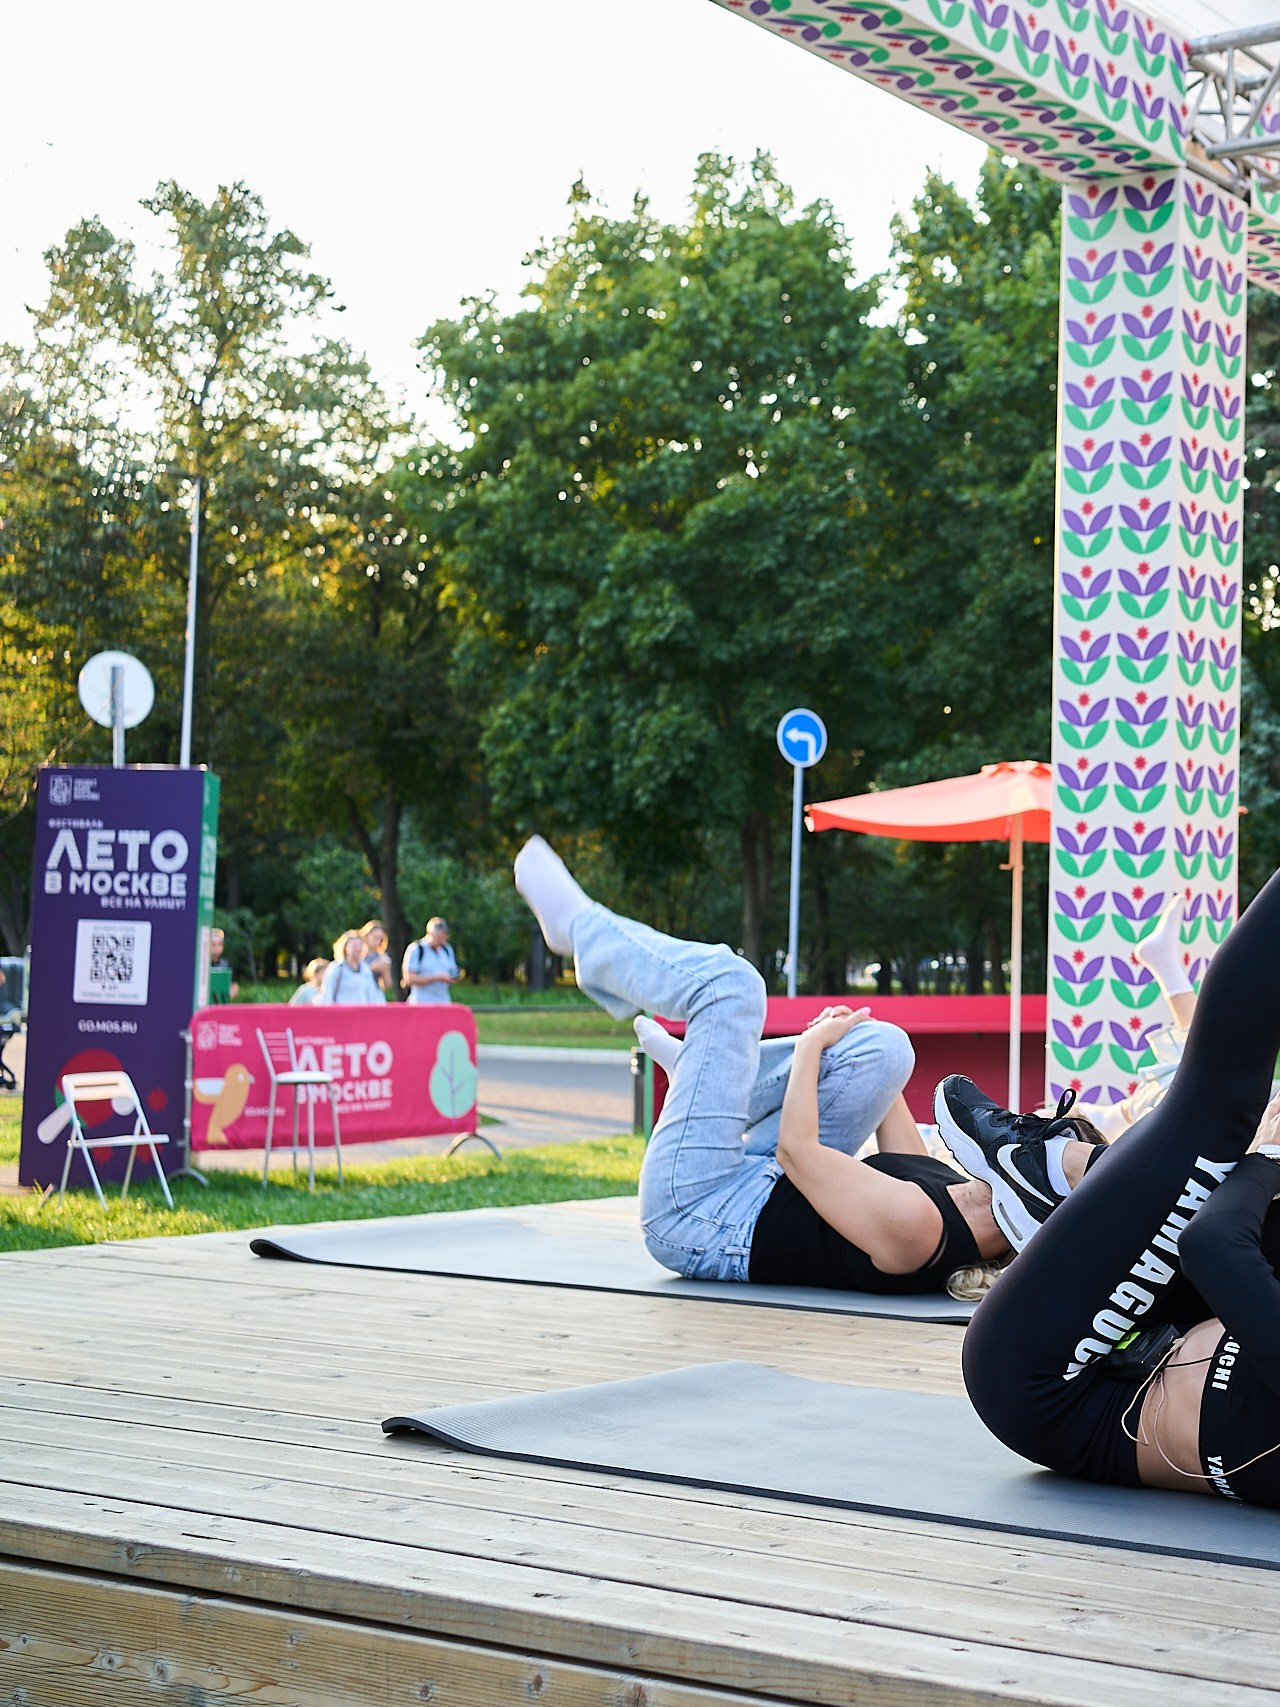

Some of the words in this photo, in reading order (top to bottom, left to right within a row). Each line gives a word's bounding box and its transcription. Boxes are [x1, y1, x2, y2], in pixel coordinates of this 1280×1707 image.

[46, 829, 189, 873] ЛЕТО
[44, 870, 62, 894] В
[69, 871, 187, 897] МОСКВЕ
[101, 896, 123, 909] ВСЕ
[125, 897, 142, 909] НА
[1211, 1335, 1241, 1391] UCHI
